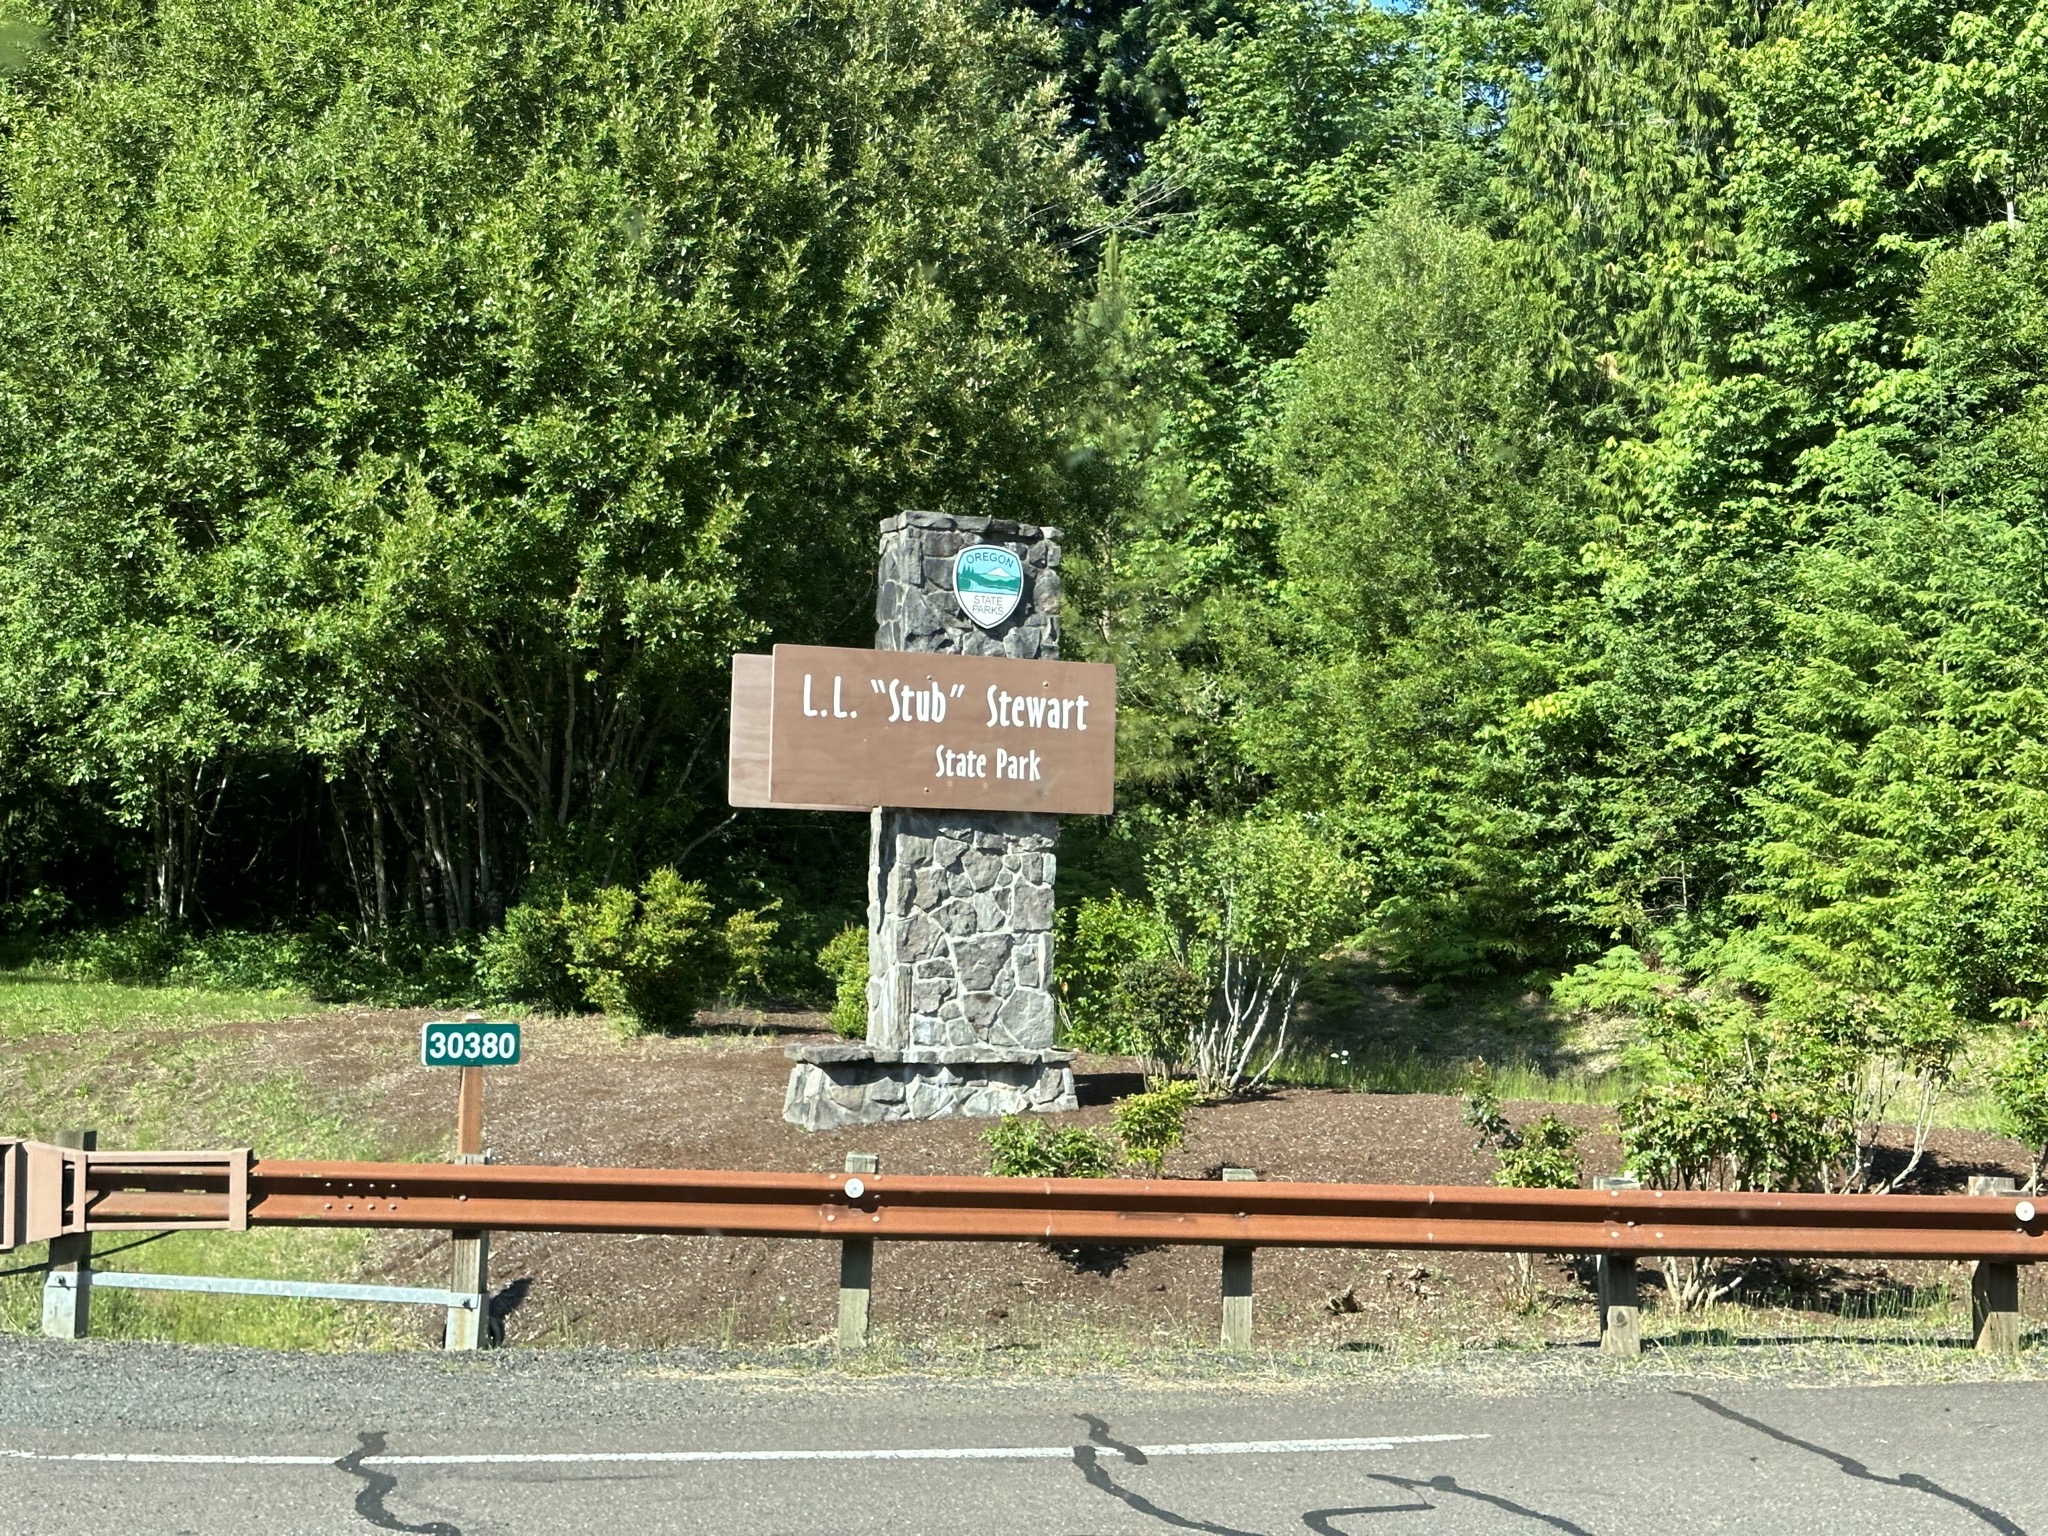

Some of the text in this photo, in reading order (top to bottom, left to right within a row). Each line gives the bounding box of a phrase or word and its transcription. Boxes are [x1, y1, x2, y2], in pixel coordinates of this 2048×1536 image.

[966, 552, 1014, 568] OREGON
[972, 605, 1004, 616] PARKS
[973, 595, 1003, 606] STATE
[802, 674, 858, 719] L.L.
[986, 684, 1089, 731] Stewart
[935, 744, 1041, 781] State Park
[429, 1031, 516, 1059] 30380
